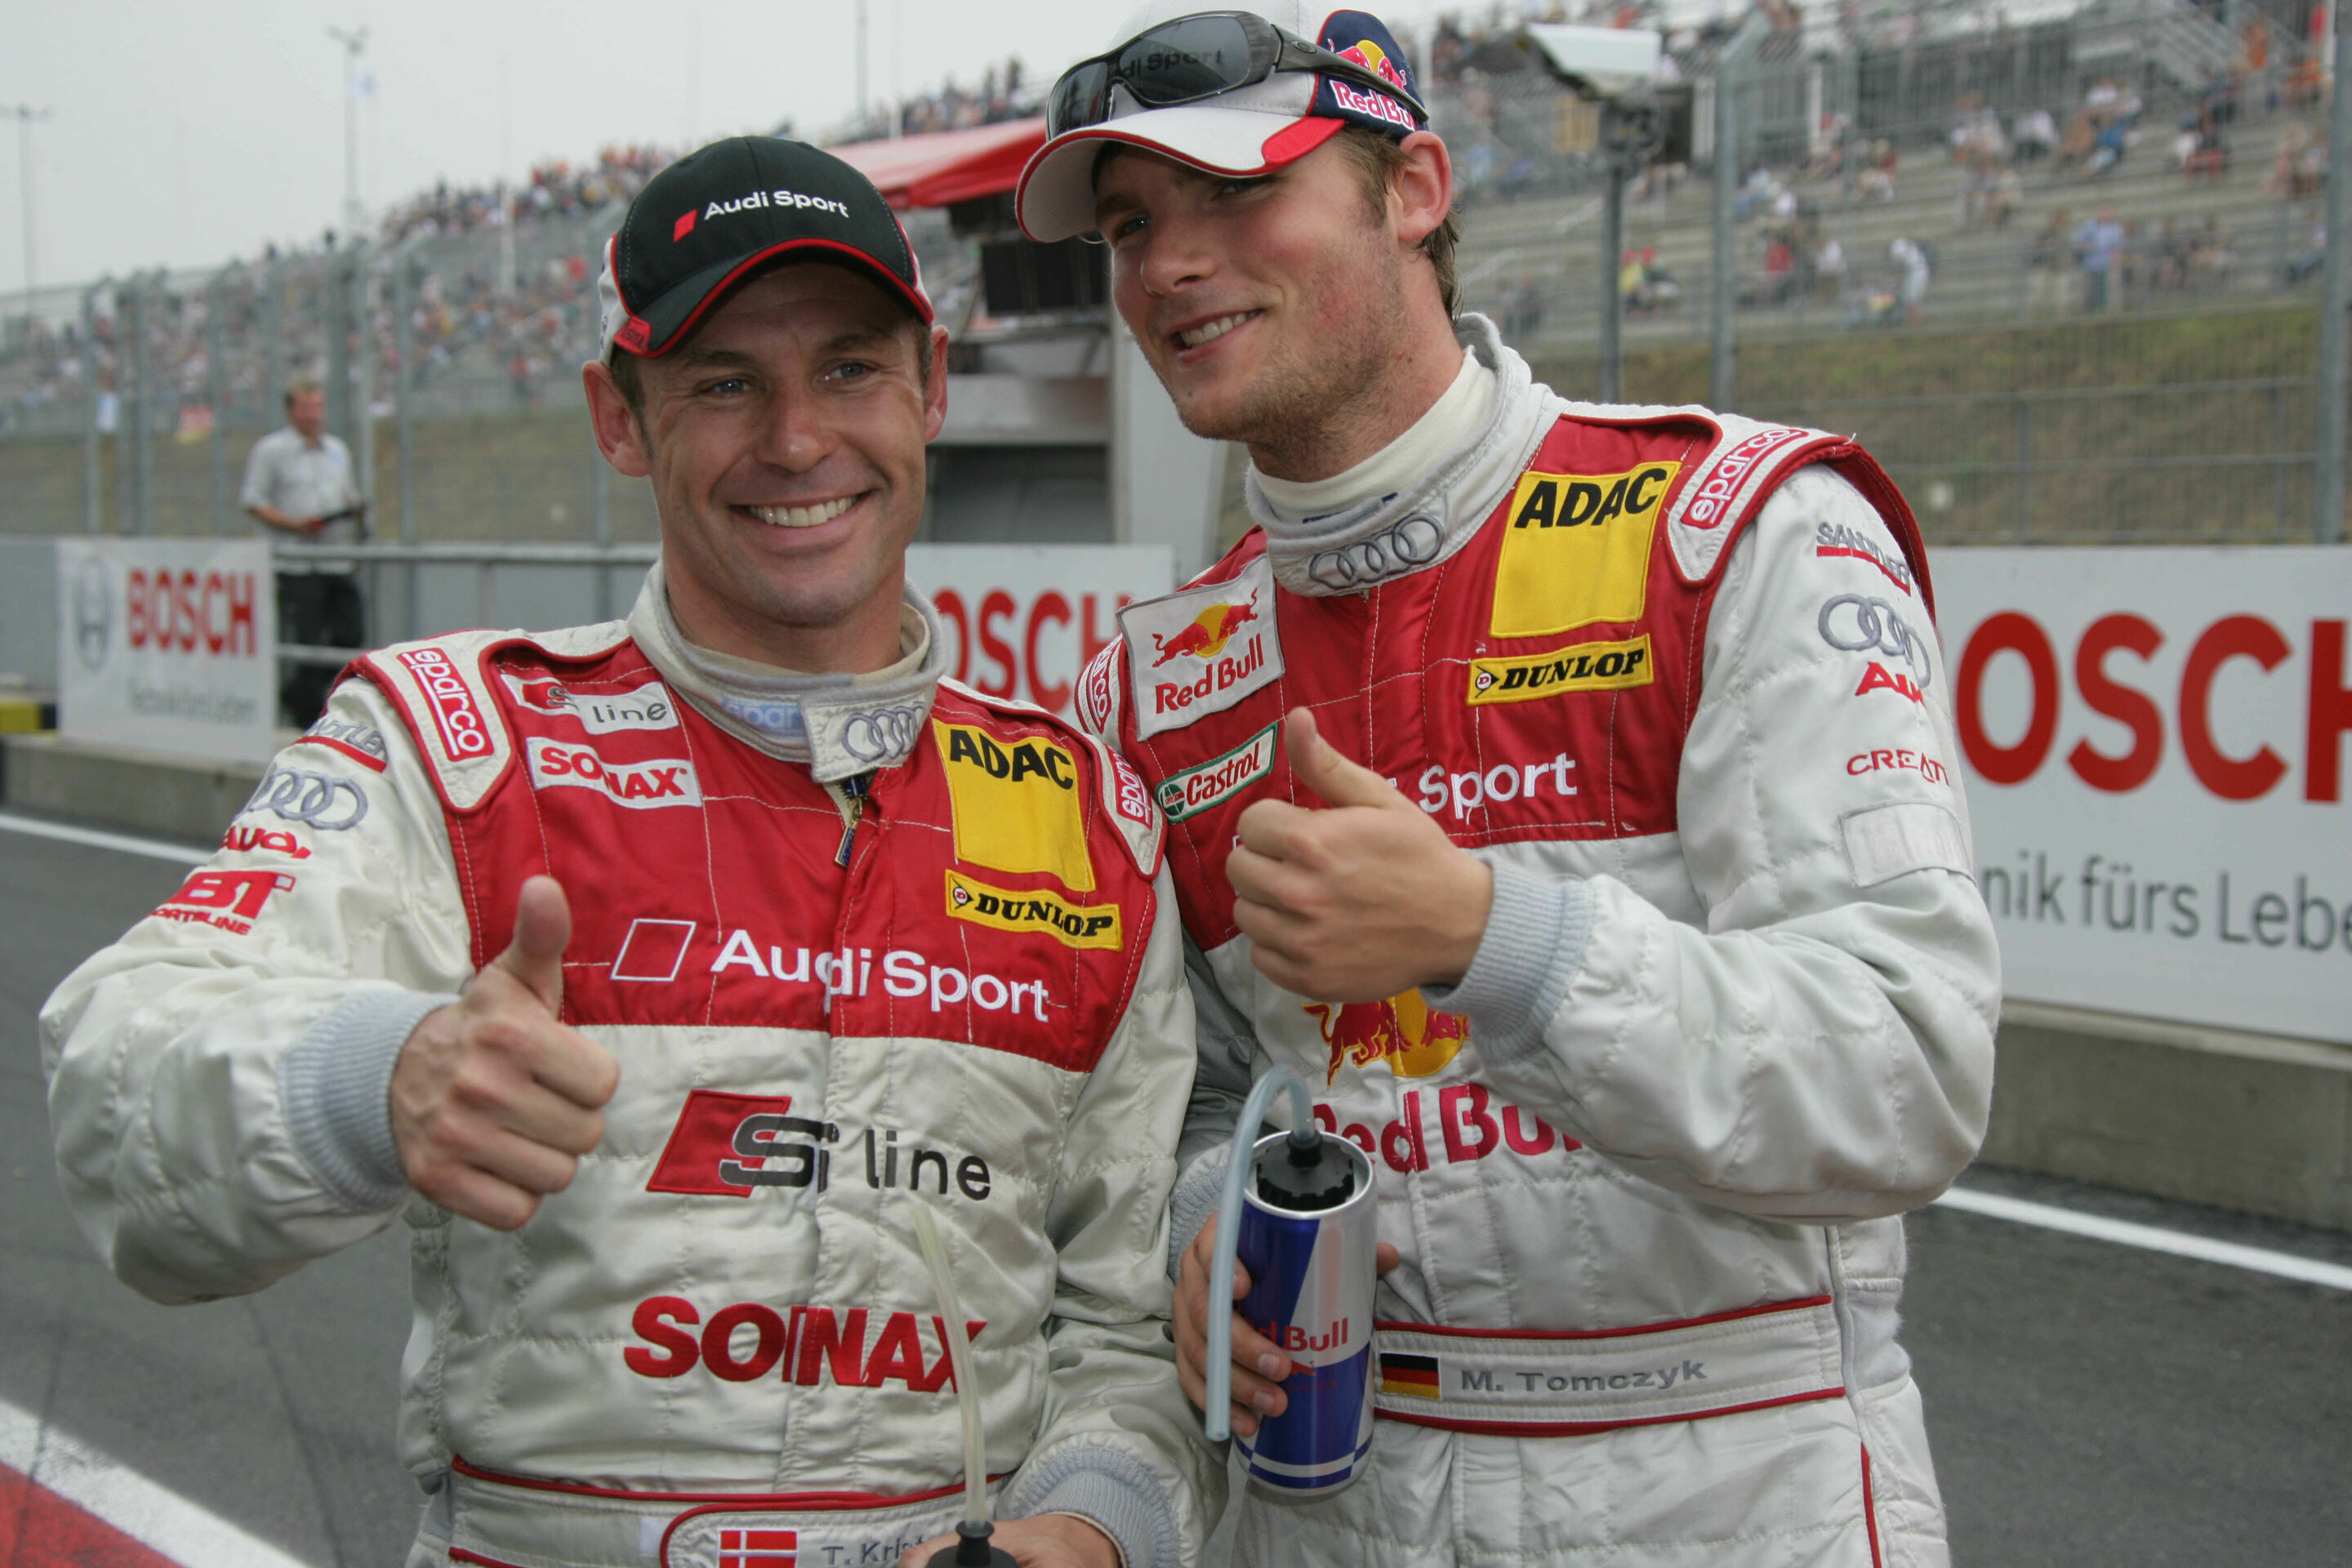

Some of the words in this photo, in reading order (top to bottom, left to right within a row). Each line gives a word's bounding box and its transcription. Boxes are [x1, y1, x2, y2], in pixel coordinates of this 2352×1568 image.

[1330, 80, 1385, 119] Red
[1378, 94, 1417, 130] Bu
[704, 191, 769, 220] Audi
[773, 190, 849, 218] Sport
[1514, 468, 1668, 528] ADAC
[1690, 429, 1790, 521] sparco
[128, 567, 256, 657] BOSCH
[932, 586, 1135, 715] OSCH
[1155, 663, 1213, 714] Red
[1218, 633, 1264, 690] Bull
[1499, 648, 1644, 689] DUNLOP
[408, 651, 486, 753] sparco
[592, 702, 668, 723] line
[1954, 608, 2352, 804] OSCH
[541, 746, 685, 799] SONAX
[950, 729, 1073, 790] ADAC
[1187, 742, 1260, 806] Castrol
[1419, 753, 1578, 819] Sport
[1846, 750, 1950, 786] CREATI
[147, 908, 252, 936] ORTSLINE
[163, 871, 296, 919] BT
[974, 893, 1113, 937] DUNLOP
[2080, 854, 2202, 938] fürs
[2218, 871, 2352, 954] Leb
[710, 929, 872, 1001] Audi
[883, 951, 1049, 1022] Sport
[1439, 1083, 1583, 1156] Bu
[866, 1125, 991, 1200] line
[624, 1295, 987, 1393] SONAX
[1284, 1317, 1348, 1352] Bull
[1461, 1370, 1503, 1392] M.
[1516, 1360, 1707, 1392] Tomczyk
[822, 1545, 851, 1566] T.
